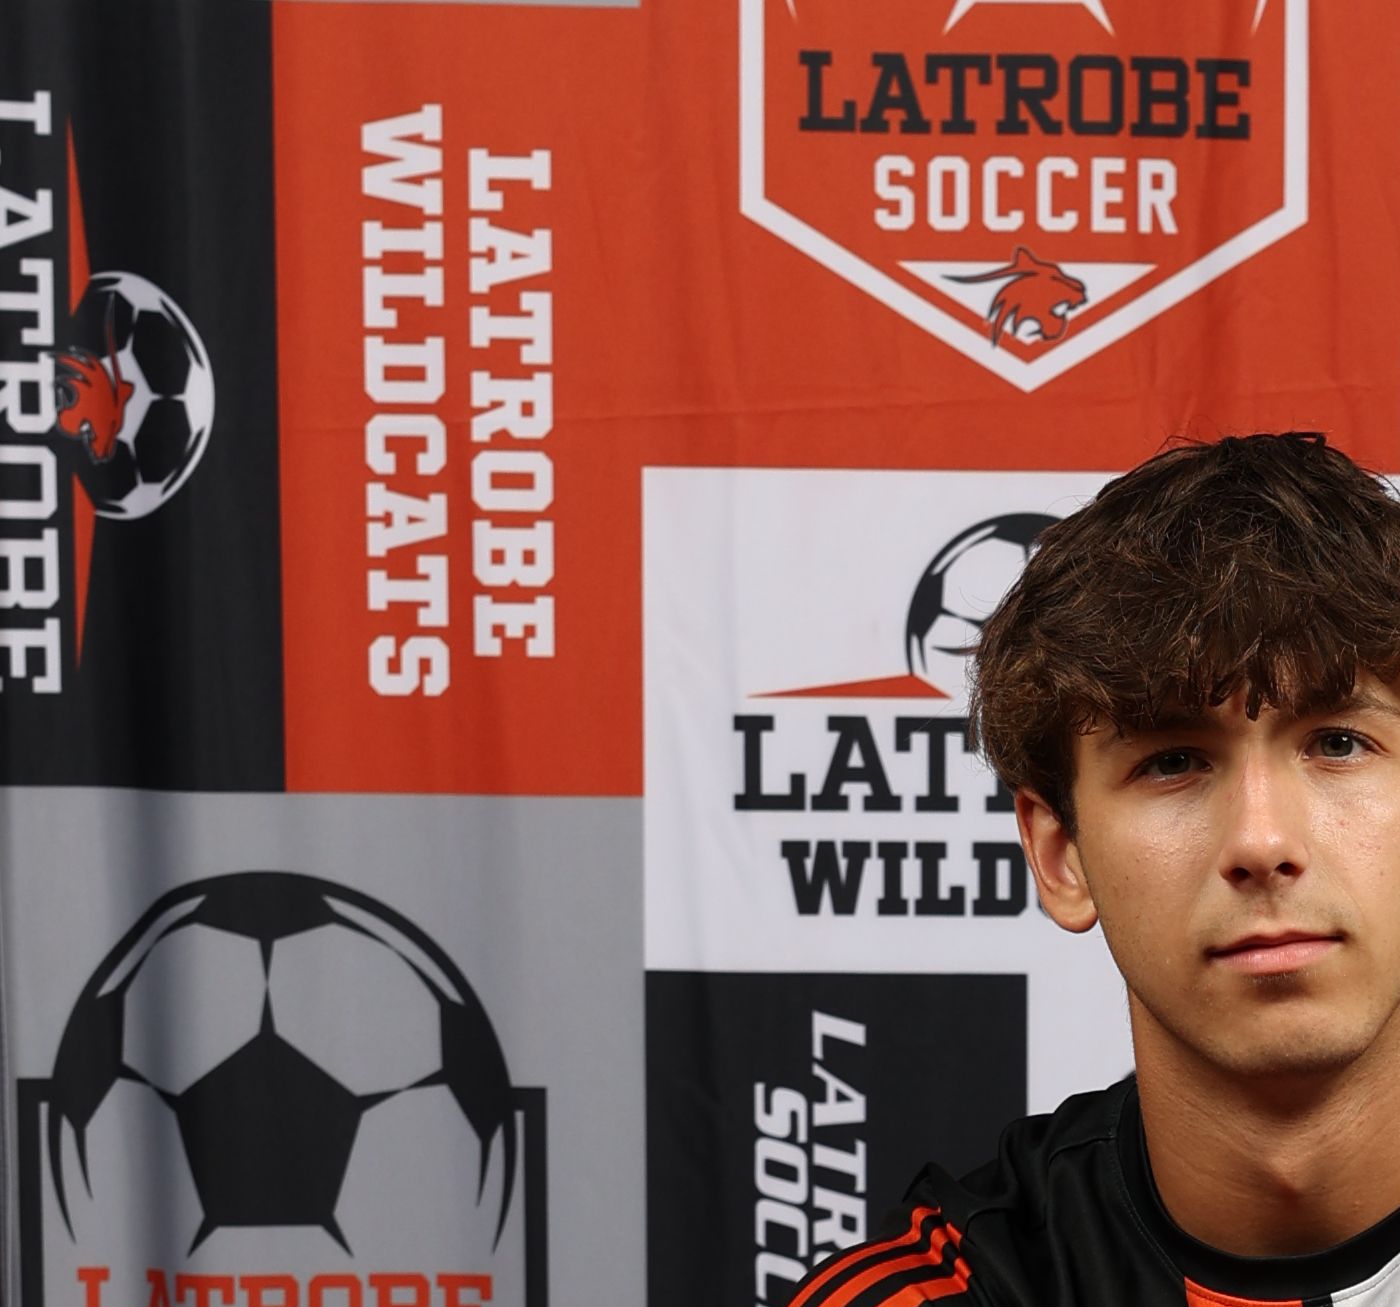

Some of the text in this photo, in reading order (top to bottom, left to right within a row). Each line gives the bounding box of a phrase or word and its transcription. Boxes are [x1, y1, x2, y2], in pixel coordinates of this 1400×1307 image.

[798, 50, 1251, 140] LATROBE
[873, 154, 1179, 235] SOCCER
[360, 104, 451, 697] WILDCATS
[468, 148, 556, 657] LATROBE
[733, 714, 1016, 813] LAT
[781, 840, 1046, 917] WILD
[811, 1010, 867, 1266] LATR
